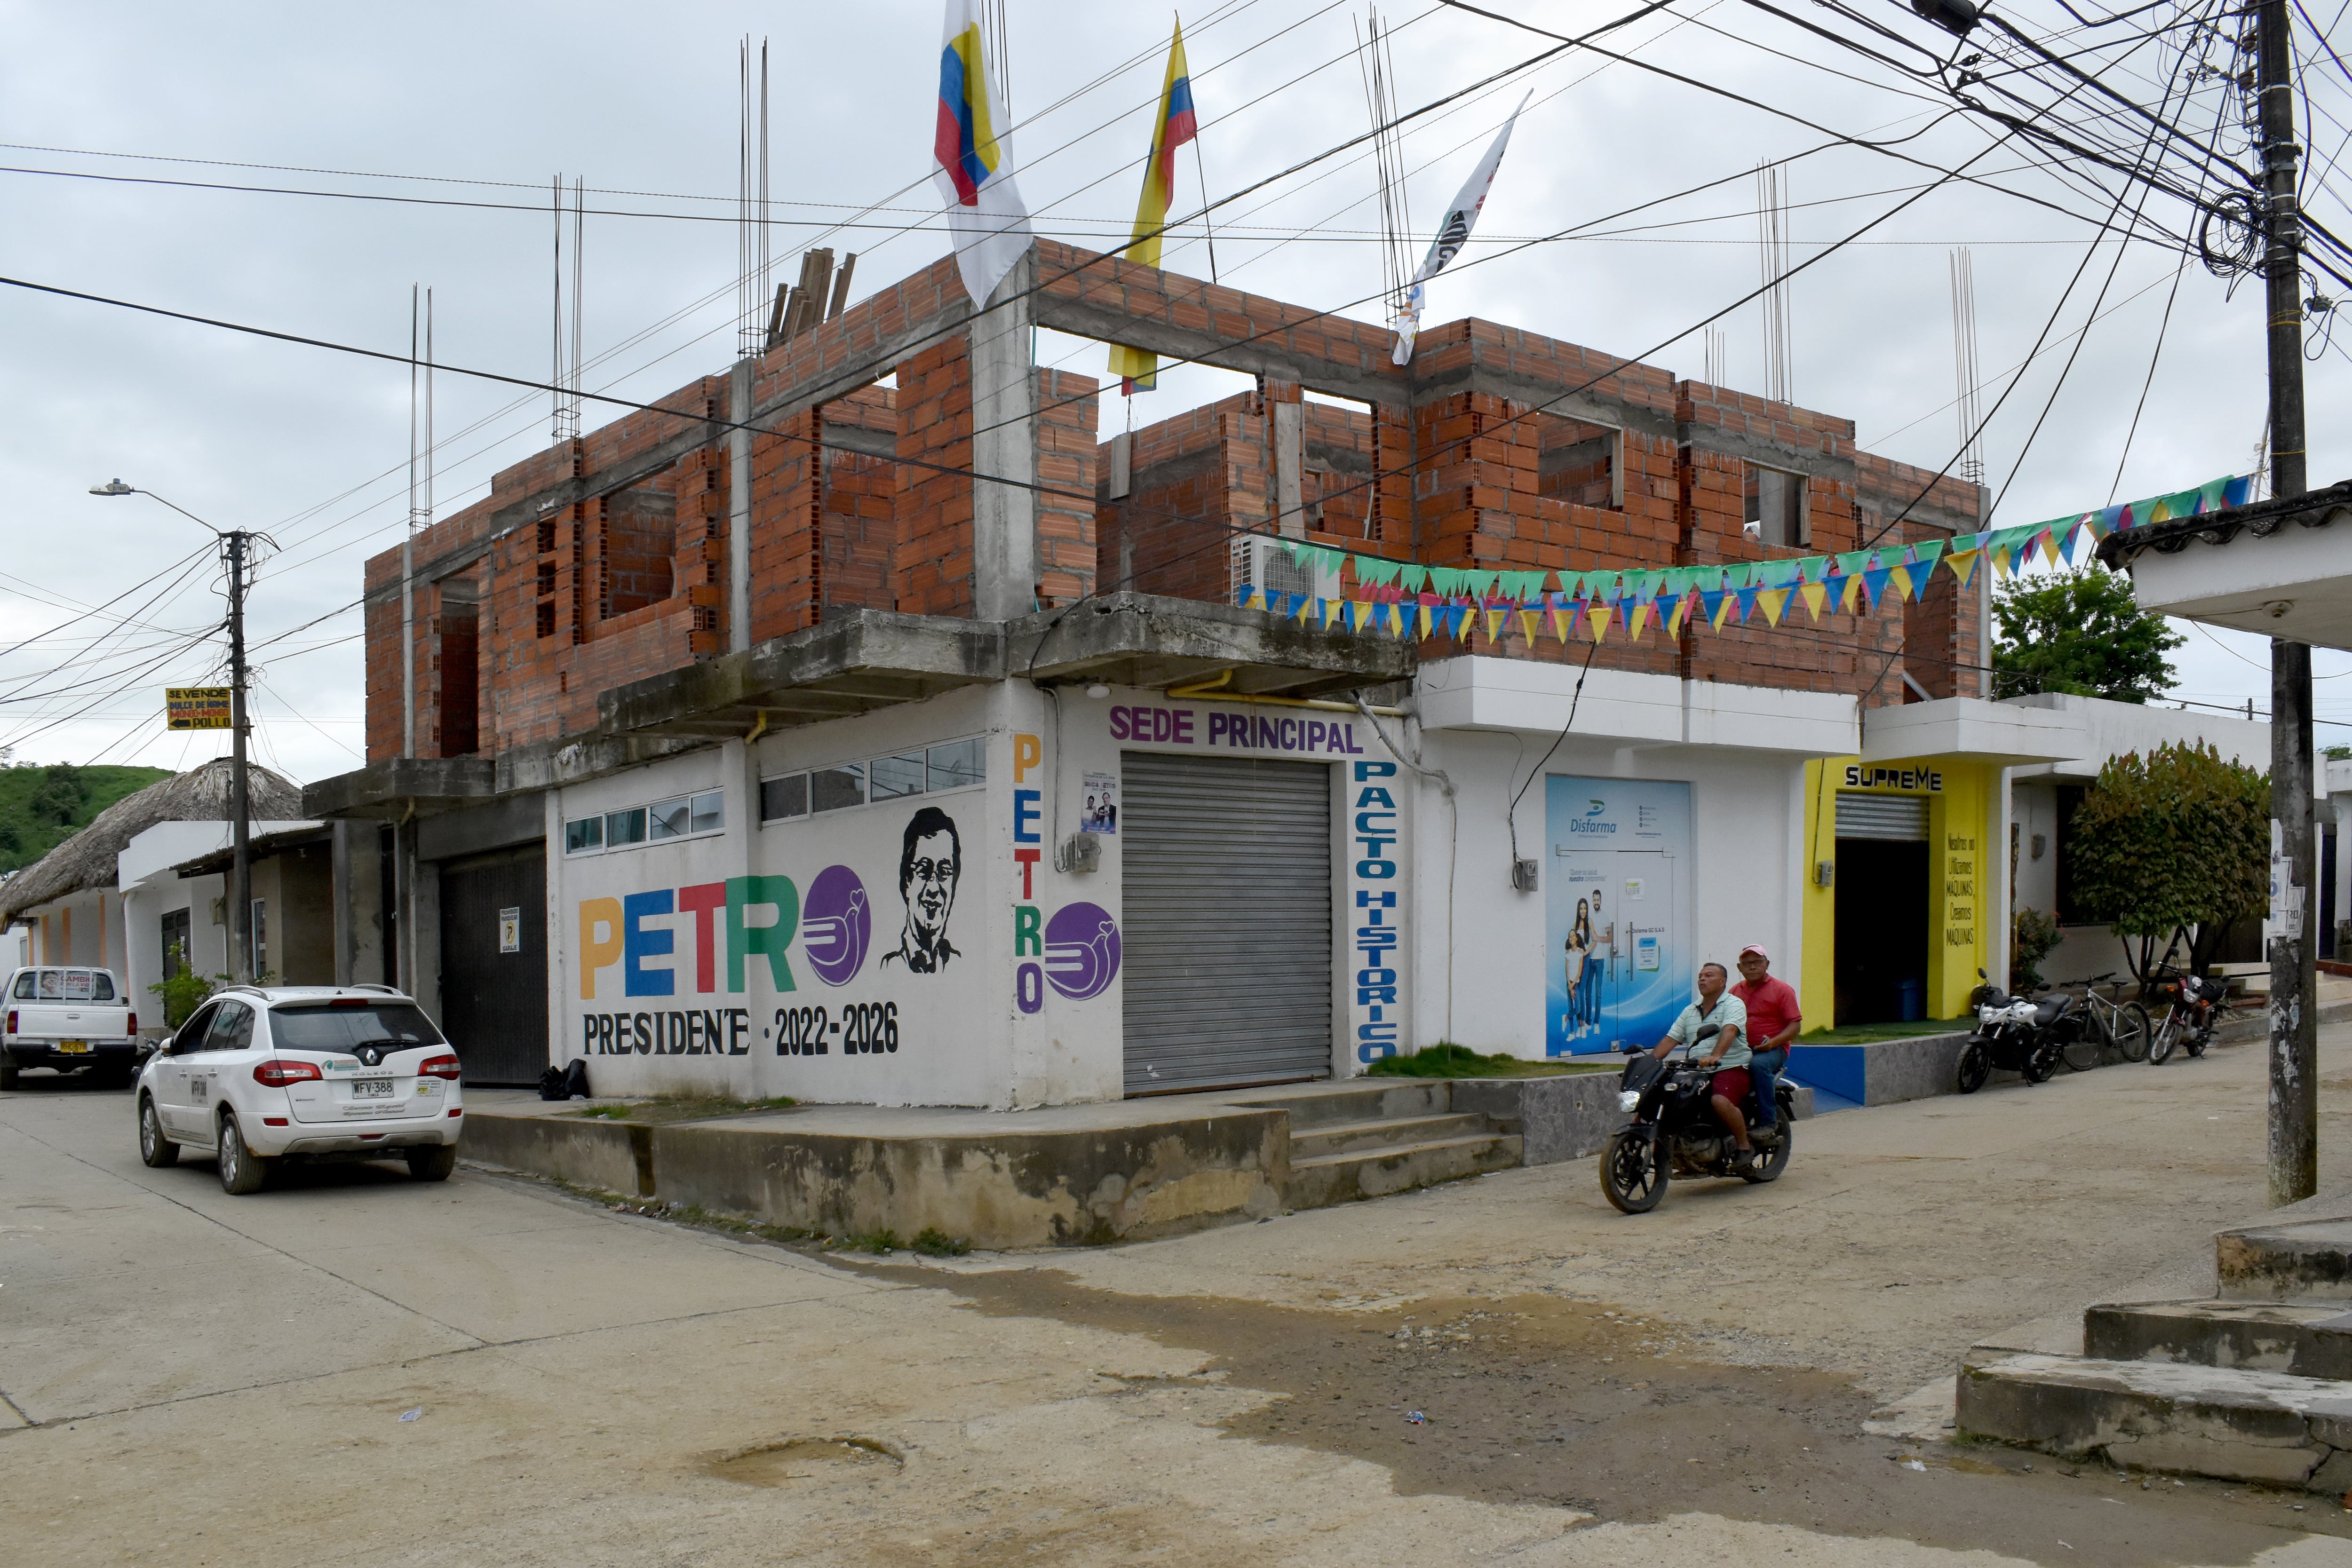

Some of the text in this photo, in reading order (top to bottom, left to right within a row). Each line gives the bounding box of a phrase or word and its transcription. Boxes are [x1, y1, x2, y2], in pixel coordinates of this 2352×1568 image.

[168, 689, 228, 698] SE VENDE
[169, 701, 193, 710] DULCE
[196, 700, 205, 709] DE
[192, 717, 230, 728] POLLO
[1110, 705, 1364, 754] SEDE PRINCIPAL
[1845, 763, 1942, 791] SUPREME
[1570, 818, 1617, 833] Disfarma
[1948, 832, 1975, 851] Nosotros no
[1014, 734, 1043, 1014] PETRO
[1948, 856, 1972, 875] Utilizamos
[1355, 760, 1397, 1064] PACTO HISTORICO
[1950, 902, 1971, 920] Creamos
[579, 864, 871, 1000] PETRO
[1946, 923, 1974, 947] MÁQUINAS
